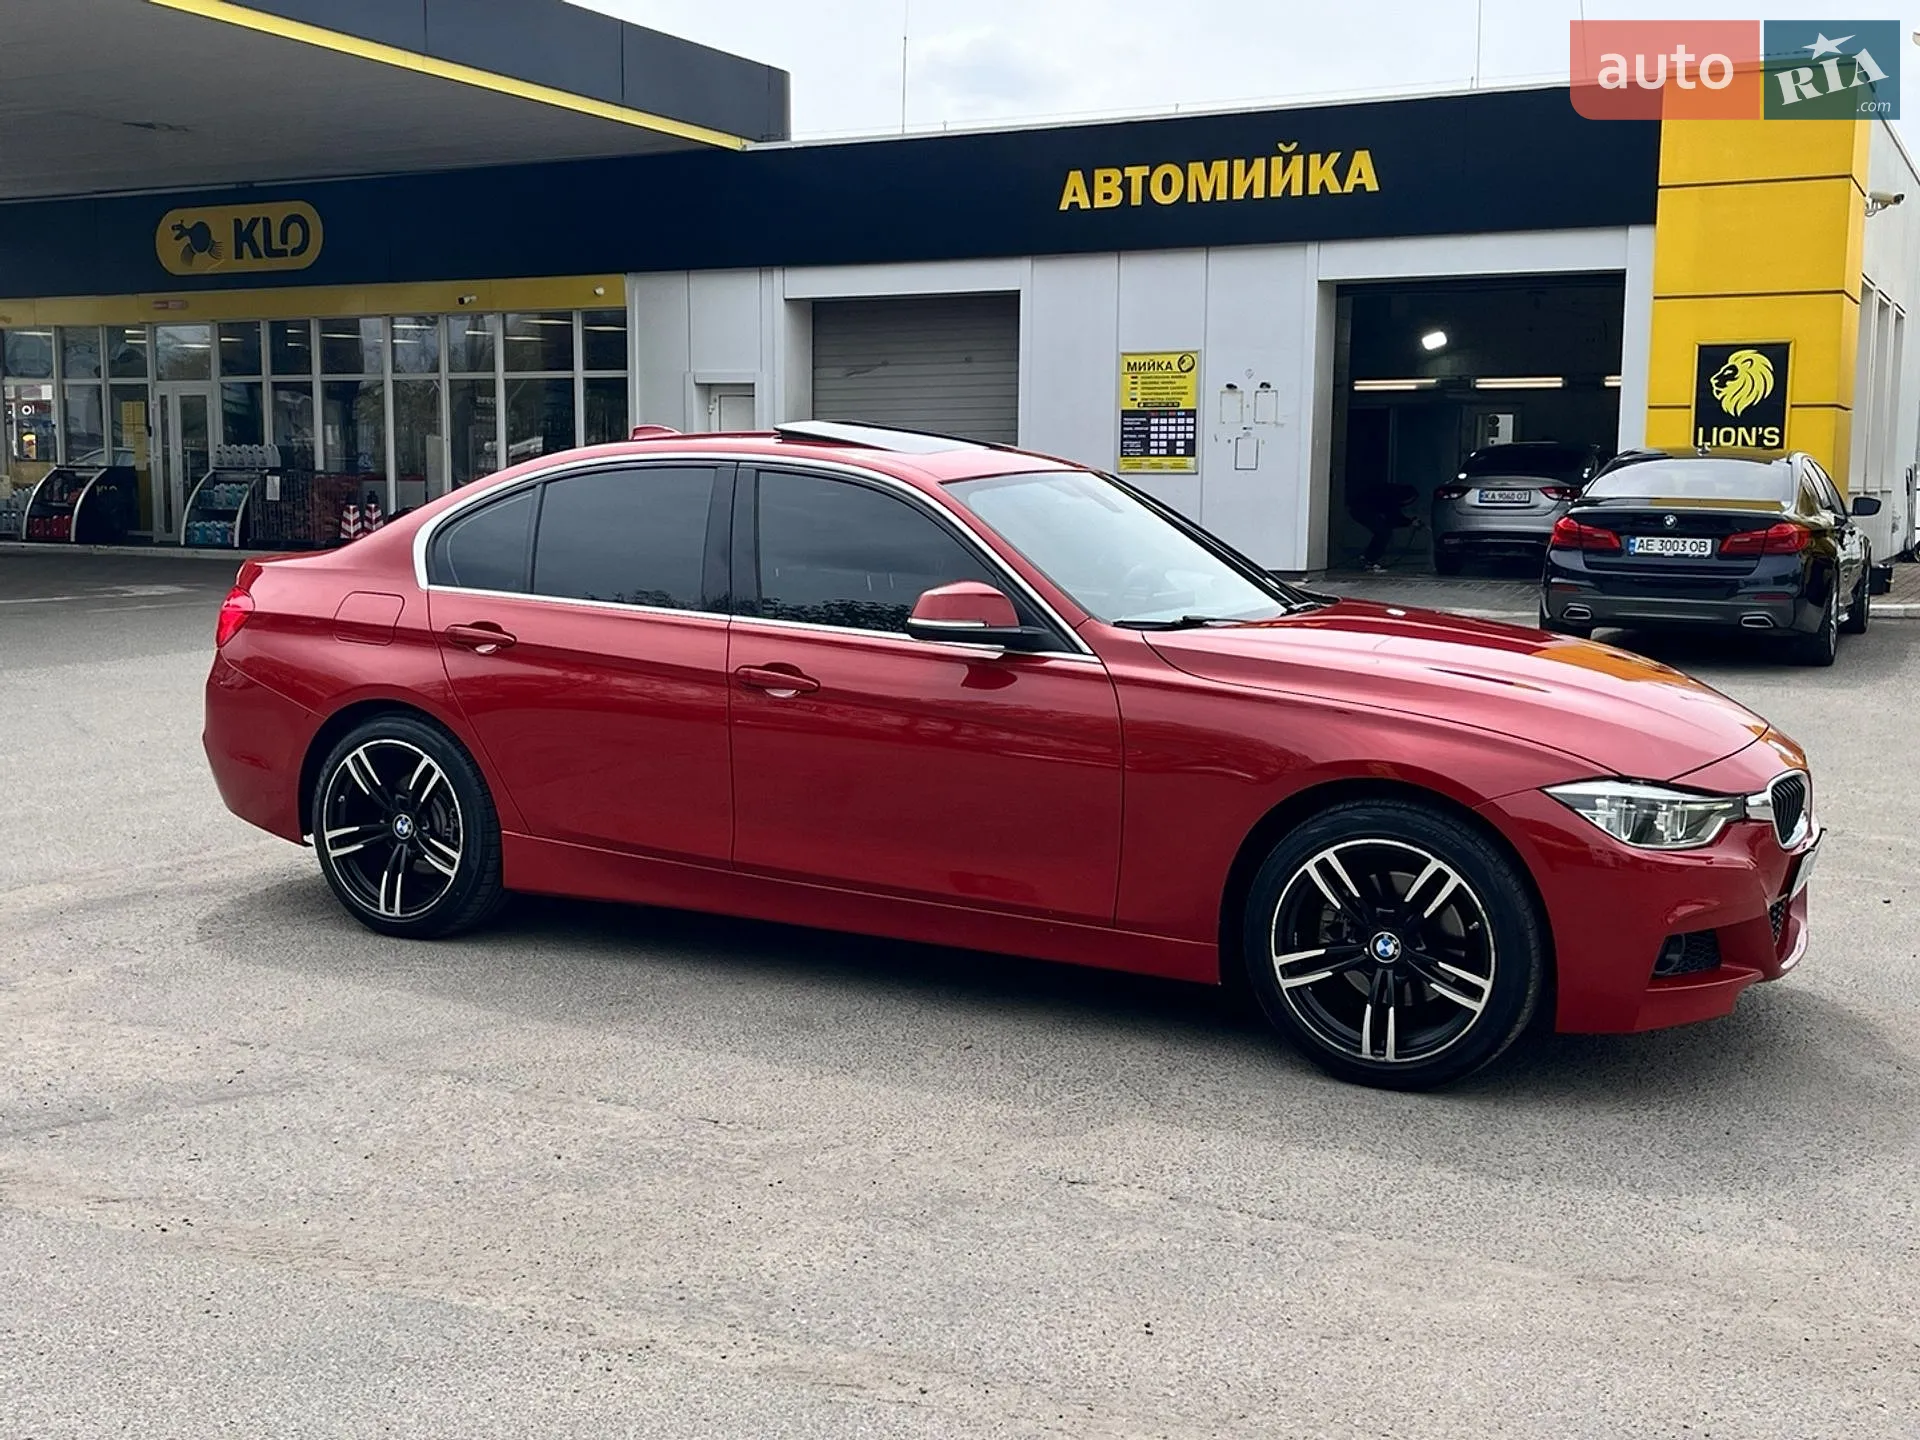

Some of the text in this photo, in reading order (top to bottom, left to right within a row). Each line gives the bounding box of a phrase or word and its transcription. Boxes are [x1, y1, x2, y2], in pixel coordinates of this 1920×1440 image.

[1059, 141, 1380, 211] АВТОМИЙКА
[233, 213, 310, 260] KLO
[1126, 359, 1173, 372] МИЙКА
[1697, 426, 1780, 447] LION'S
[1637, 539, 1708, 552] AE 3003 OB
